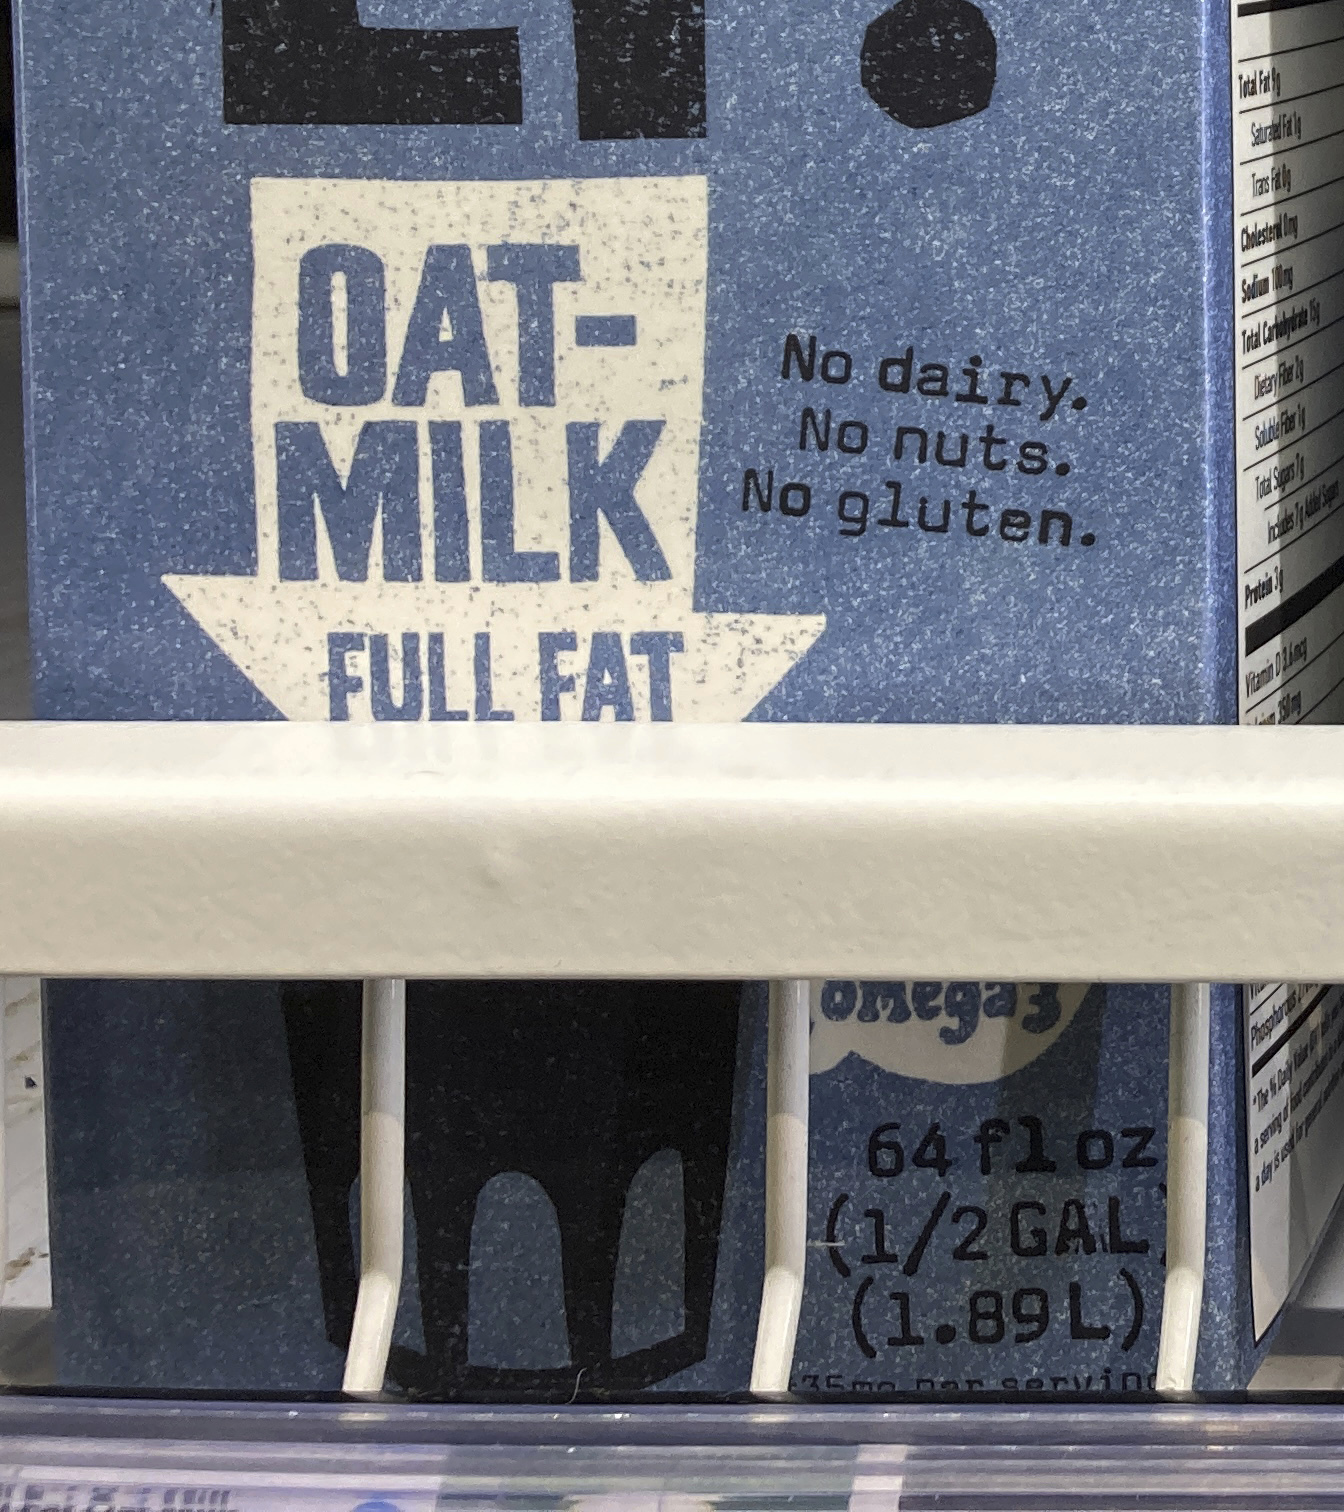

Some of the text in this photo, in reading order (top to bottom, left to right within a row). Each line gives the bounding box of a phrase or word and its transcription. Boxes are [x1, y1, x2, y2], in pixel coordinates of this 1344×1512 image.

[1238, 70, 1257, 99] Total
[1259, 68, 1271, 95] Fat
[1252, 173, 1270, 198] Trans
[296, 242, 638, 408] OAT-
[1241, 323, 1262, 355] Total
[780, 332, 1091, 423] No dairy.
[798, 405, 1073, 478] No nuts.
[272, 418, 674, 584] MILK
[740, 467, 1097, 548] No gluten.
[1255, 467, 1273, 501] Total
[1244, 572, 1273, 610] Protein
[325, 629, 686, 722] FULL FAT
[1275, 652, 1281, 676] D
[867, 1114, 1158, 1178] 64 fl oz
[825, 1191, 989, 1277] (1/2
[852, 1267, 1145, 1359] (1.89 L)
[1002, 1368, 1157, 1391] servin
